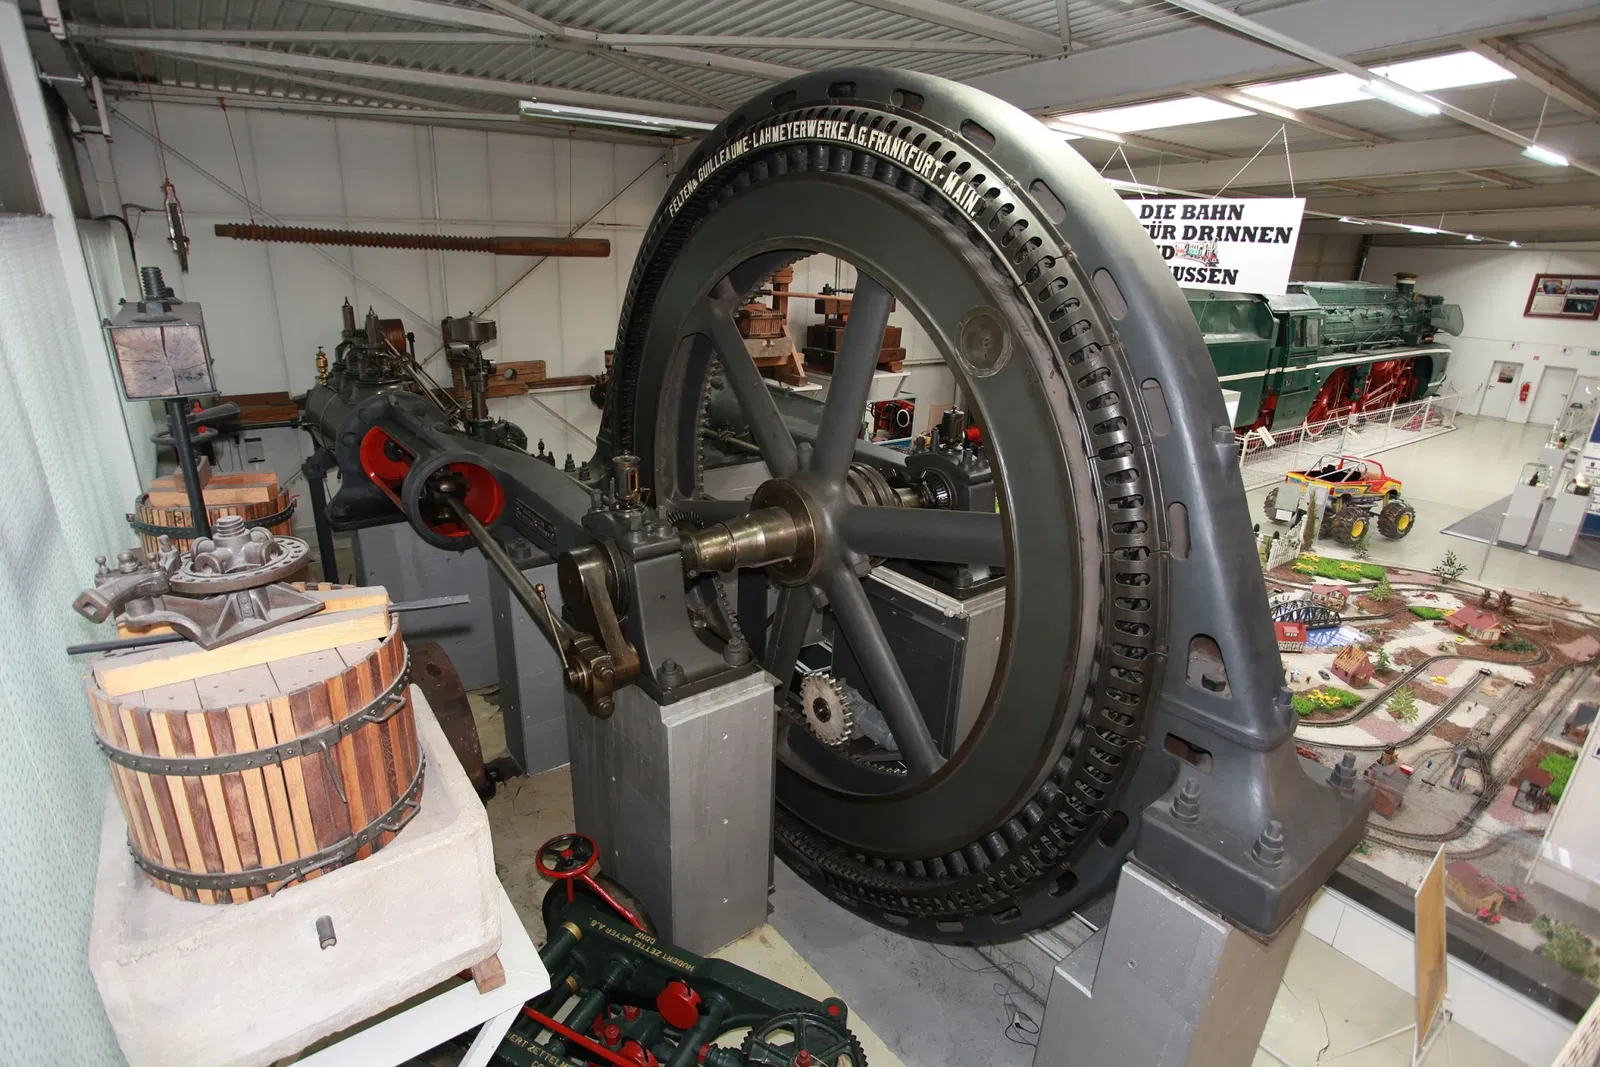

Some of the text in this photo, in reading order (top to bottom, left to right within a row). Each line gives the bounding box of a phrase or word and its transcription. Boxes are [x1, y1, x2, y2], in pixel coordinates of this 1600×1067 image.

[1139, 204, 1245, 220] DIE BAHN
[1181, 225, 1293, 244] DRINNEN
[1168, 266, 1239, 285] USSEN
[605, 927, 662, 957] ZETTELMEYER
[634, 930, 656, 945] CONZ
[661, 953, 696, 972] HUBERT
